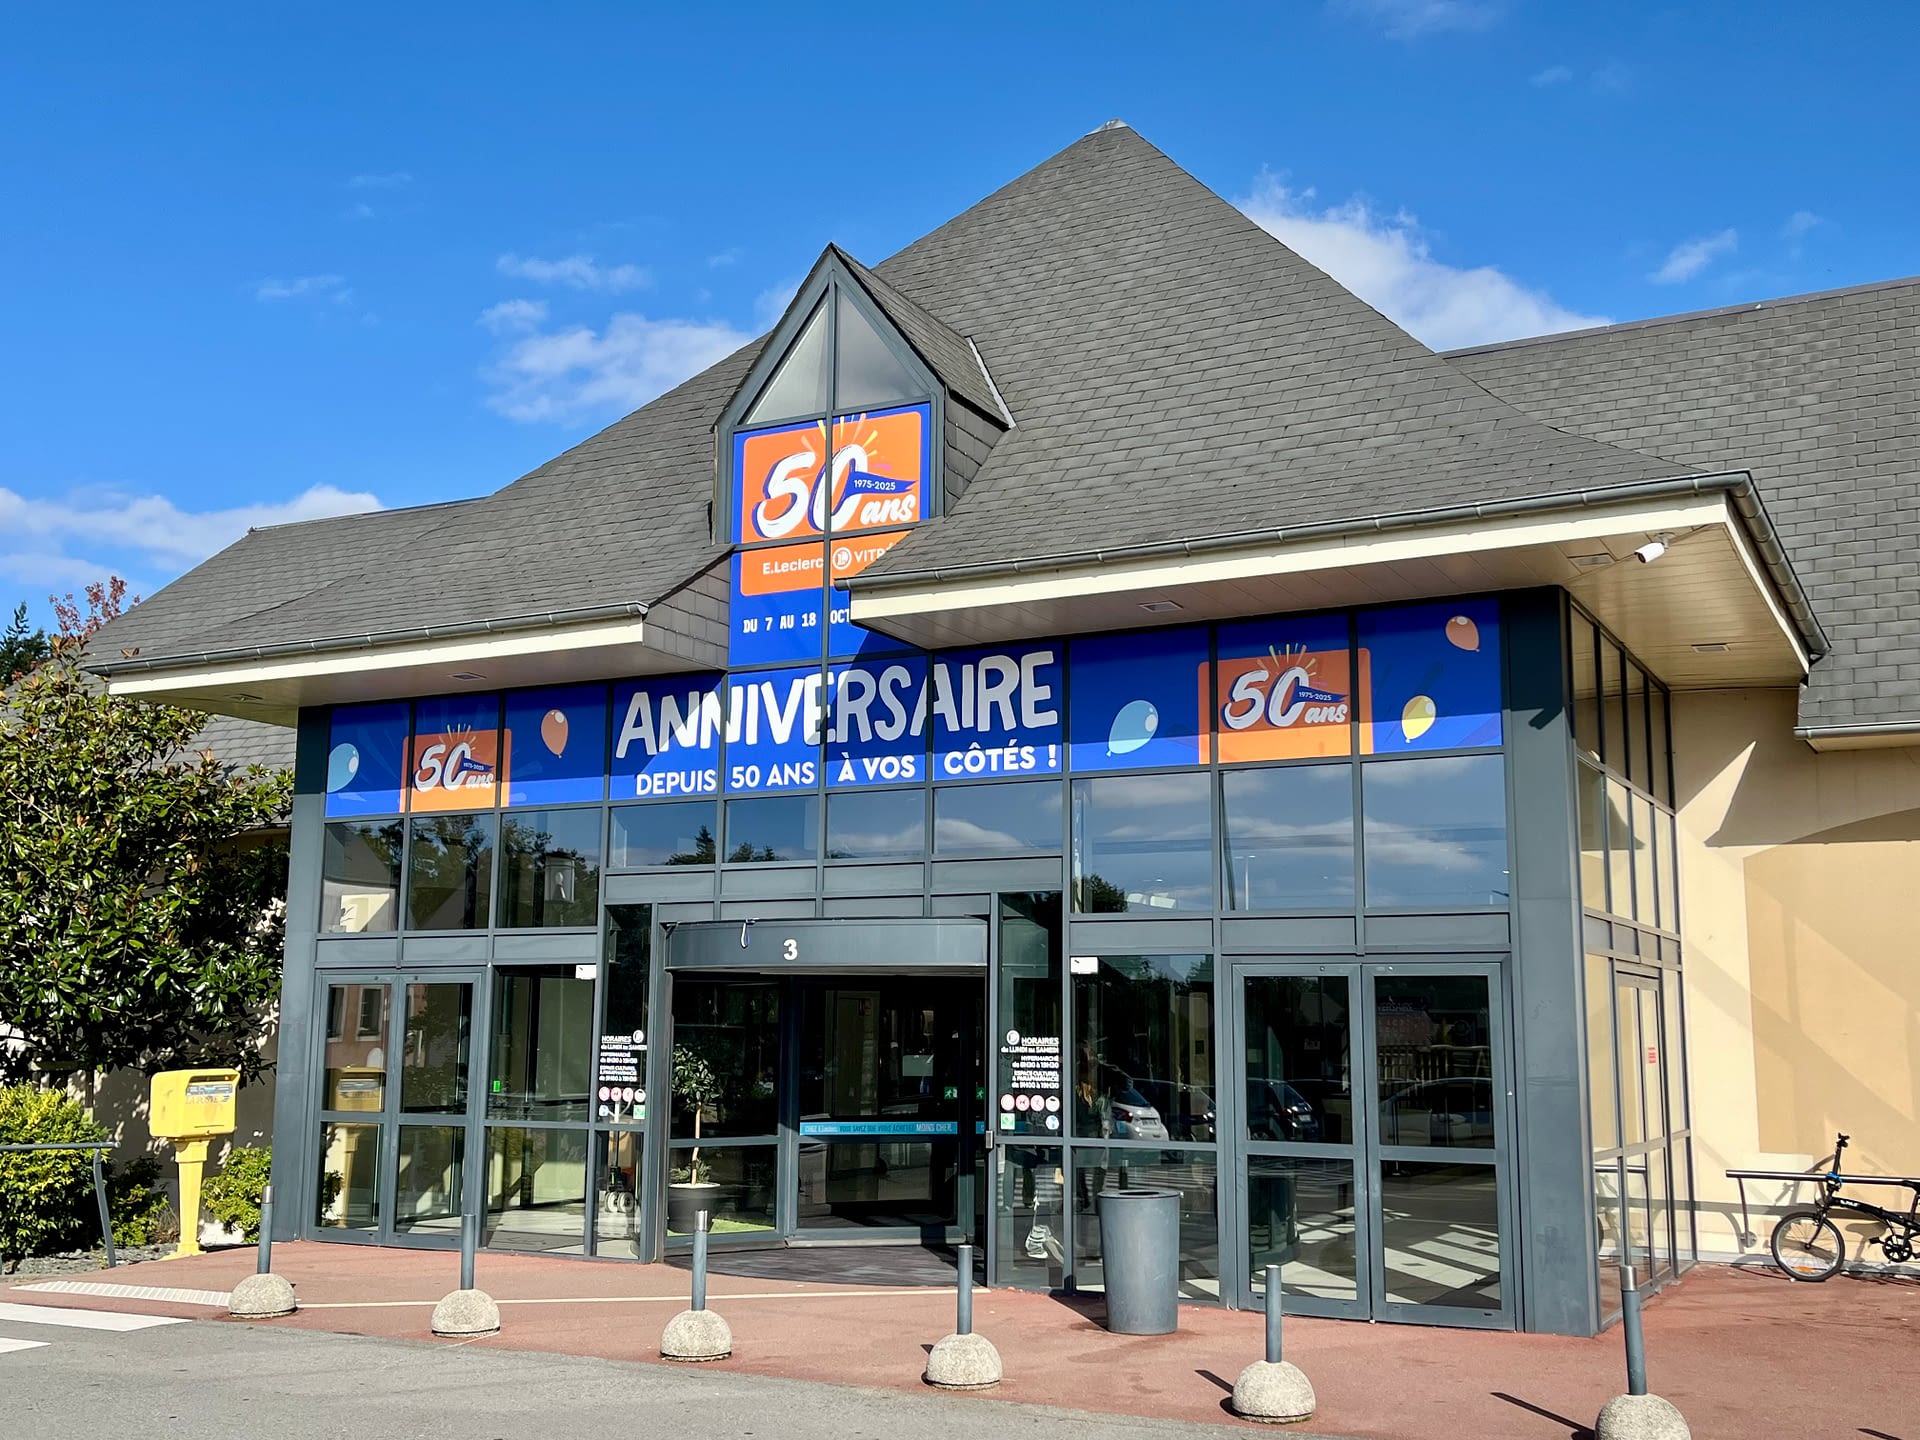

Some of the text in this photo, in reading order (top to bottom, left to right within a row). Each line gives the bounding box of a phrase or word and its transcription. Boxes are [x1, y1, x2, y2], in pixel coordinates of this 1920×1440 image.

[752, 444, 868, 538] 50
[853, 478, 897, 492] 1975-2025
[860, 494, 917, 525] ans
[762, 557, 825, 575] E.Leclerc
[743, 619, 758, 633] DU
[765, 617, 772, 631] 7
[780, 615, 794, 630] AU
[802, 613, 817, 628] 18
[615, 651, 1058, 758] ANNIVERSAIRE
[1221, 666, 1309, 730] 50
[1298, 690, 1333, 702] 1975-2025
[1304, 703, 1348, 724] ans
[414, 741, 472, 792] 50
[636, 738, 1058, 796] DEPUIS 50 ANS À VOS CÔTÉS !
[466, 773, 494, 789] ans
[783, 939, 798, 960] 3
[1021, 1037, 1060, 1045] HORAIRES
